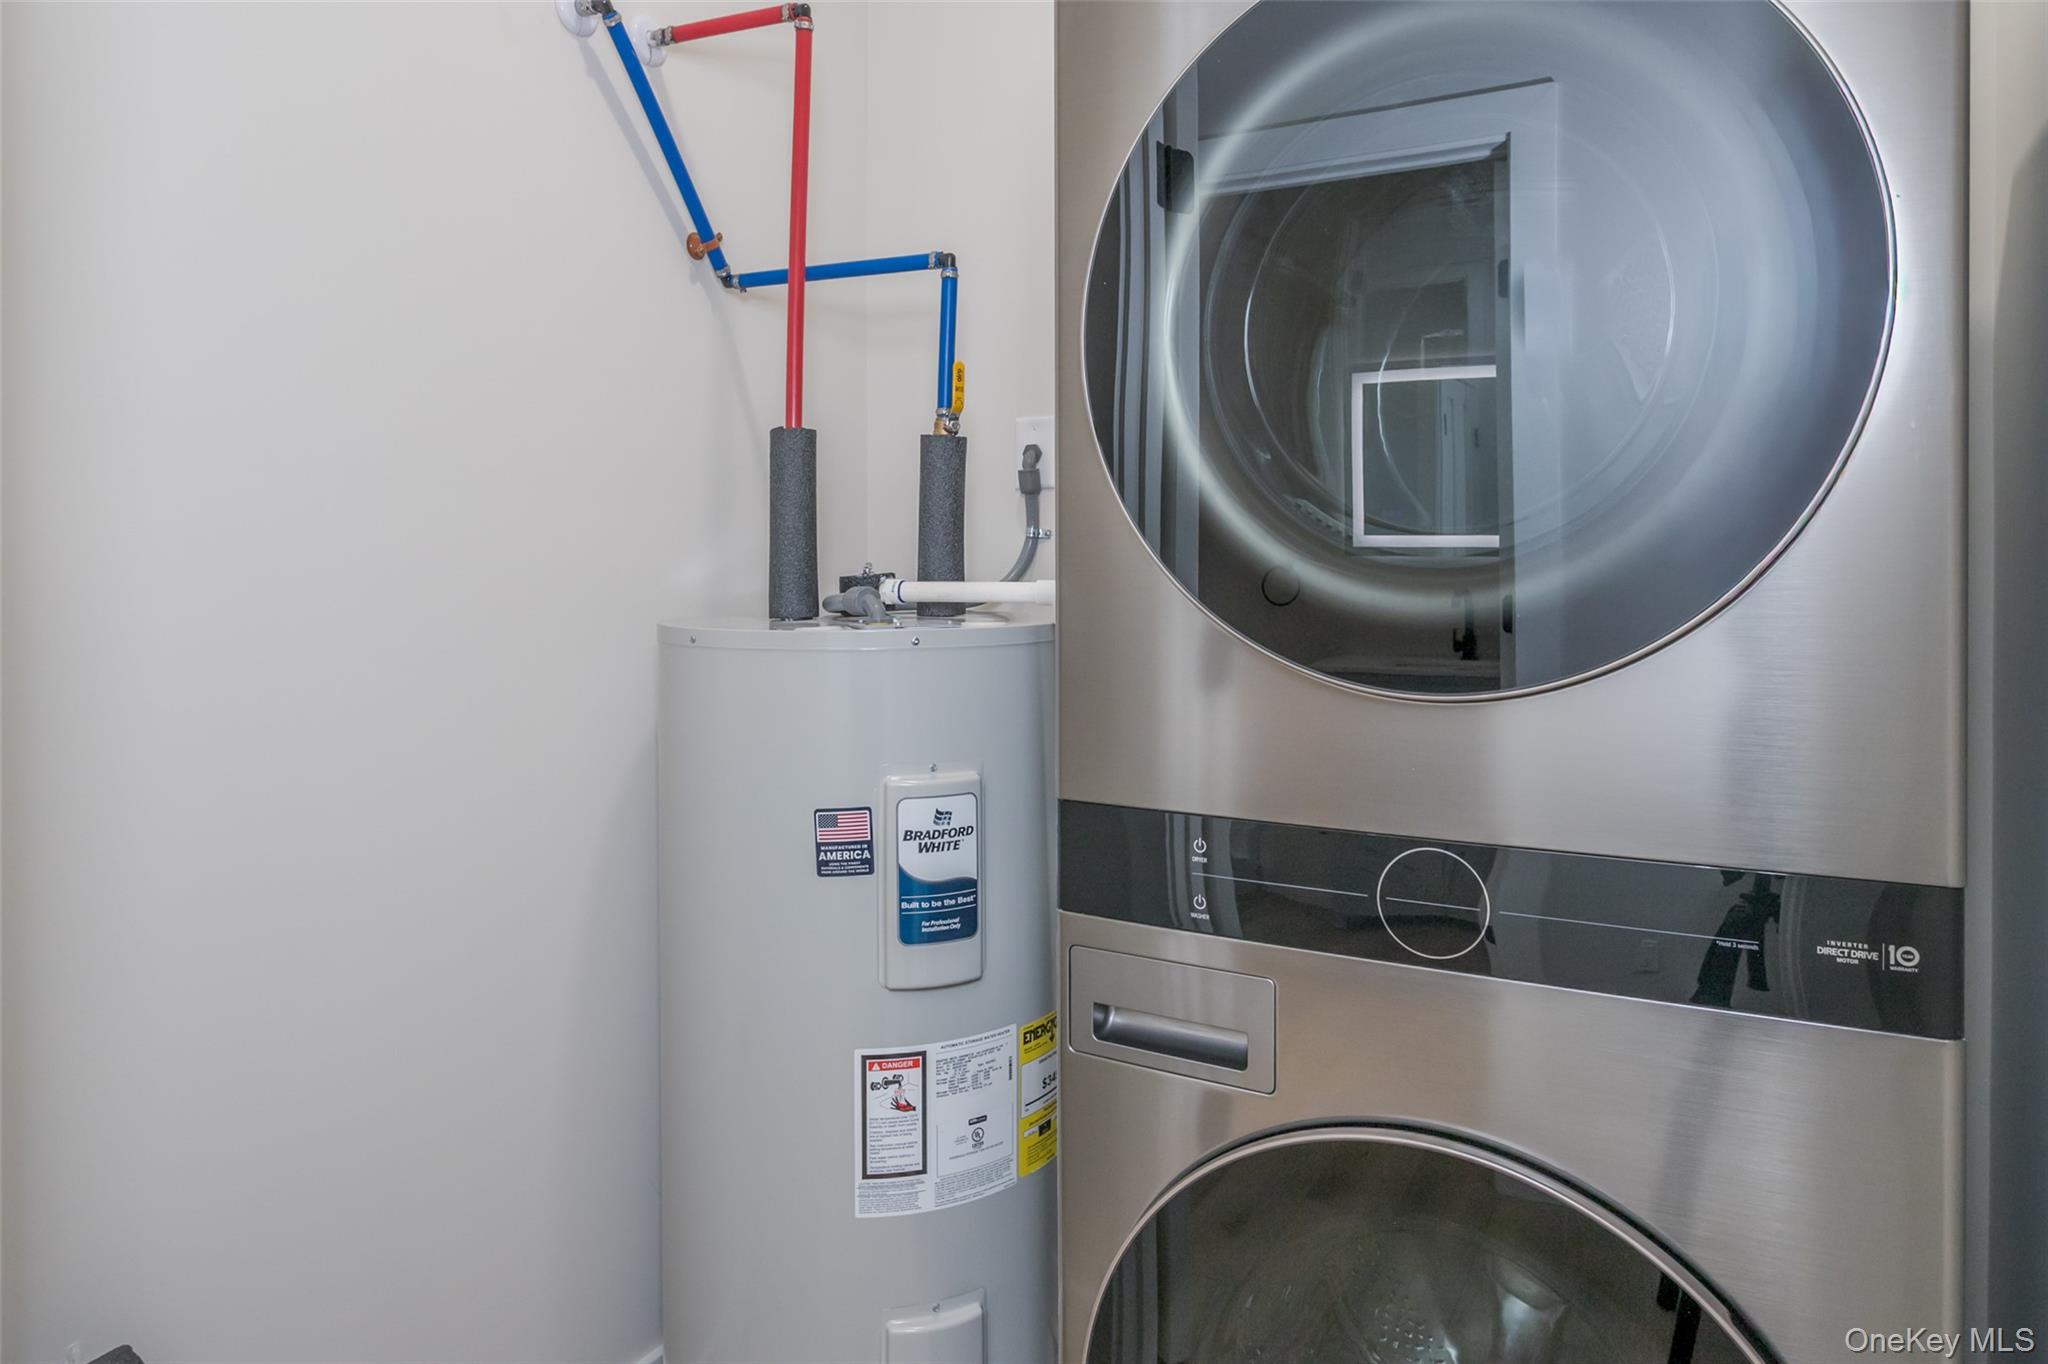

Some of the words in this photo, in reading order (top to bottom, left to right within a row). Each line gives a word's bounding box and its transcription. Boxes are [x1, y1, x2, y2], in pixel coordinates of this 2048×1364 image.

[902, 825, 974, 841] BRADFORD
[918, 840, 961, 853] WHITE
[818, 850, 871, 861] AMERICA
[901, 901, 919, 909] Built
[944, 898, 956, 906] the
[1826, 940, 1869, 949] INVERTER
[1816, 946, 1850, 957] DIRECT
[1850, 950, 1880, 960] DRIVE
[1888, 944, 1920, 967] 10
[881, 1060, 914, 1069] DANGER
